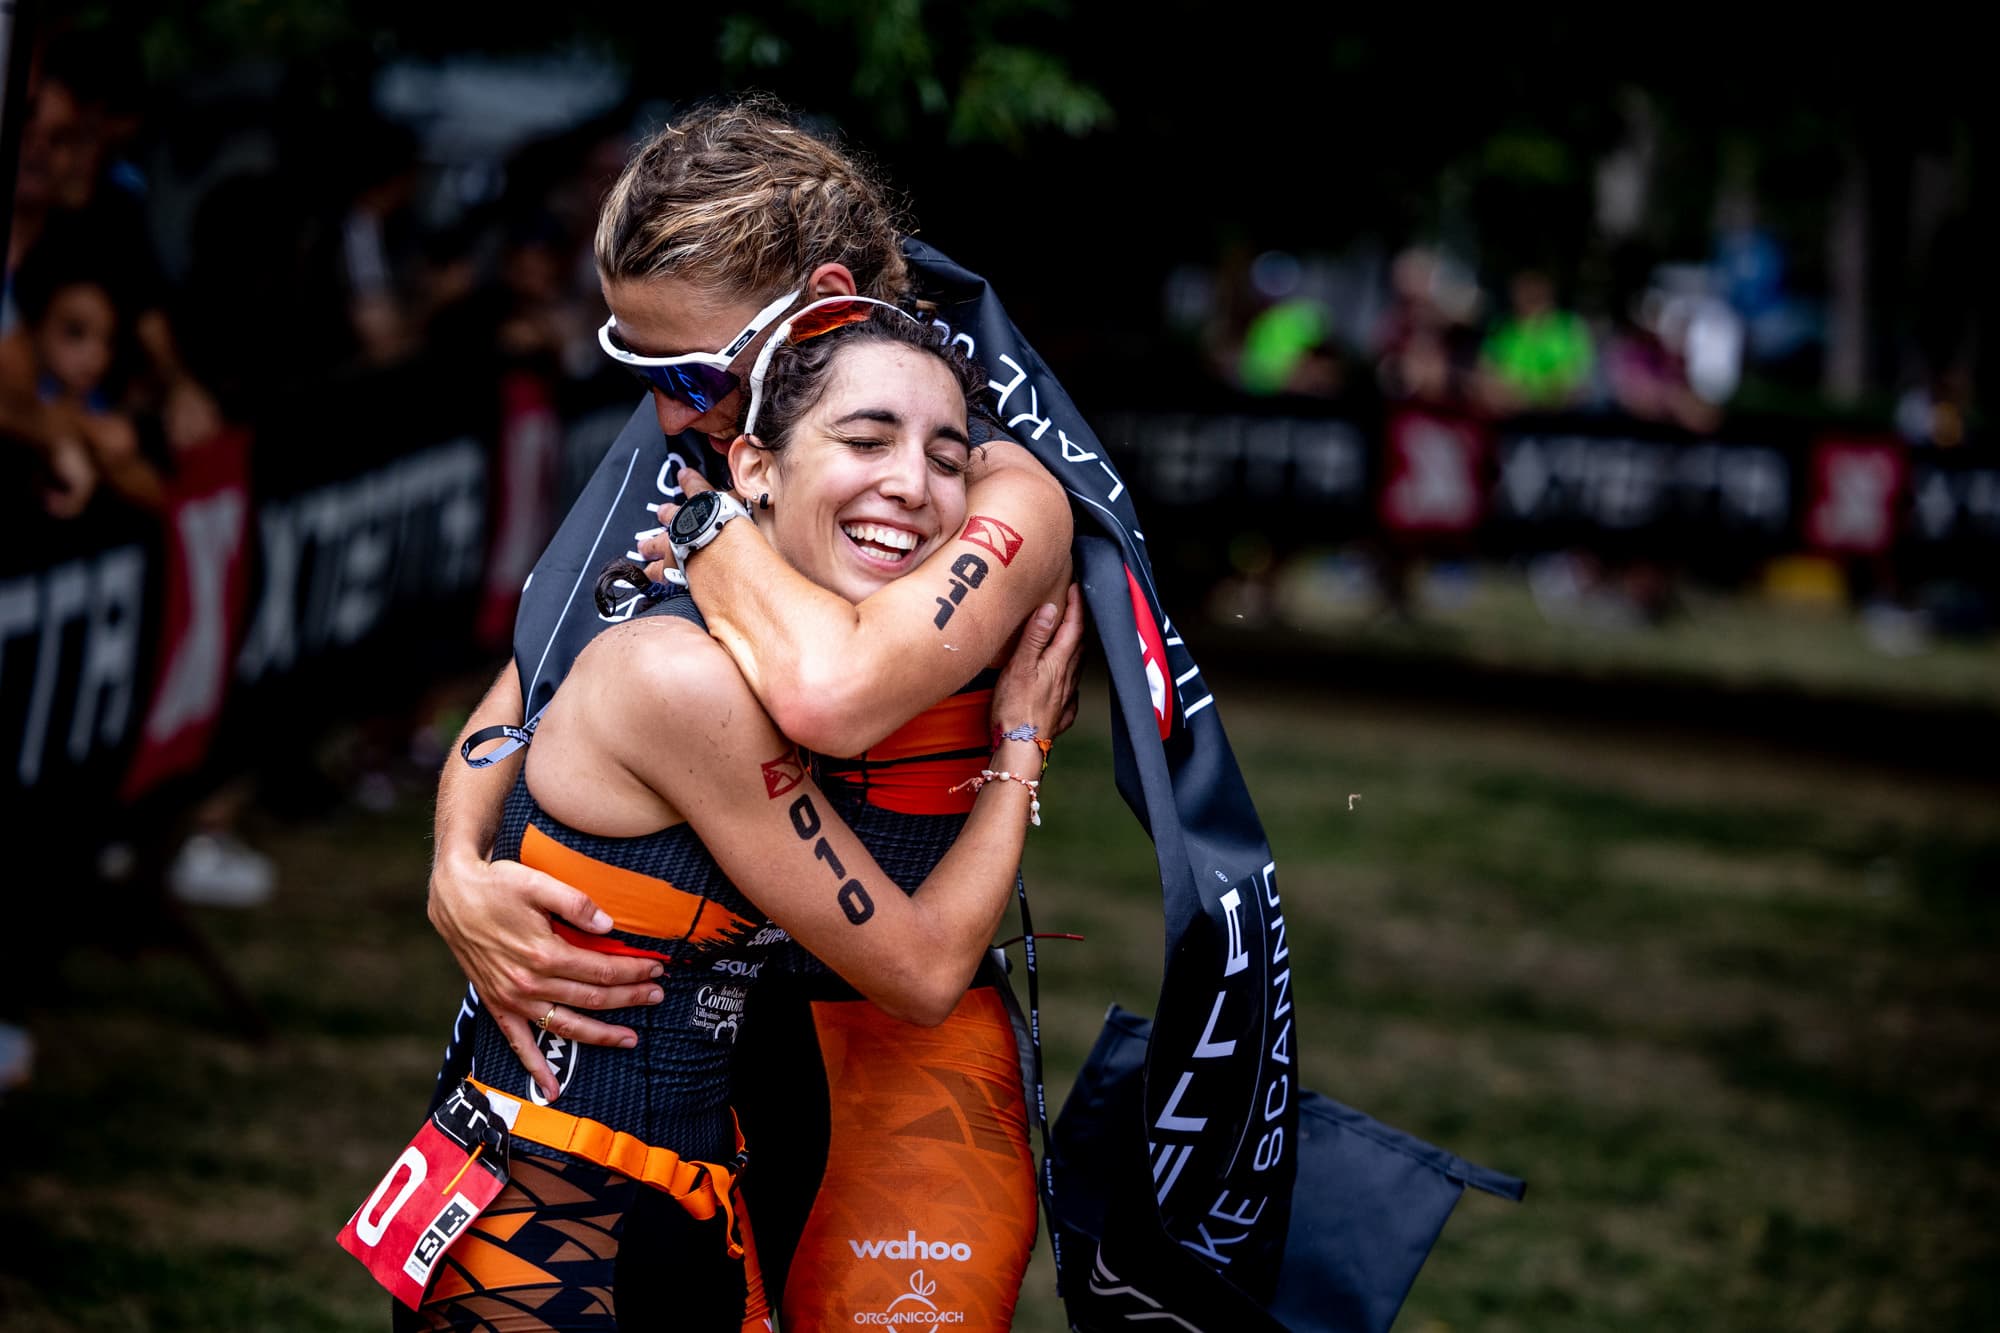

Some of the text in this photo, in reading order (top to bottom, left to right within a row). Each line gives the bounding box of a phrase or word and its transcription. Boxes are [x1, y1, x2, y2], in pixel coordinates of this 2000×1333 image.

[789, 794, 875, 926] 010
[849, 1230, 972, 1262] wahoo
[1180, 1189, 1268, 1273] KE
[854, 1311, 964, 1325] ORGANICOACH
